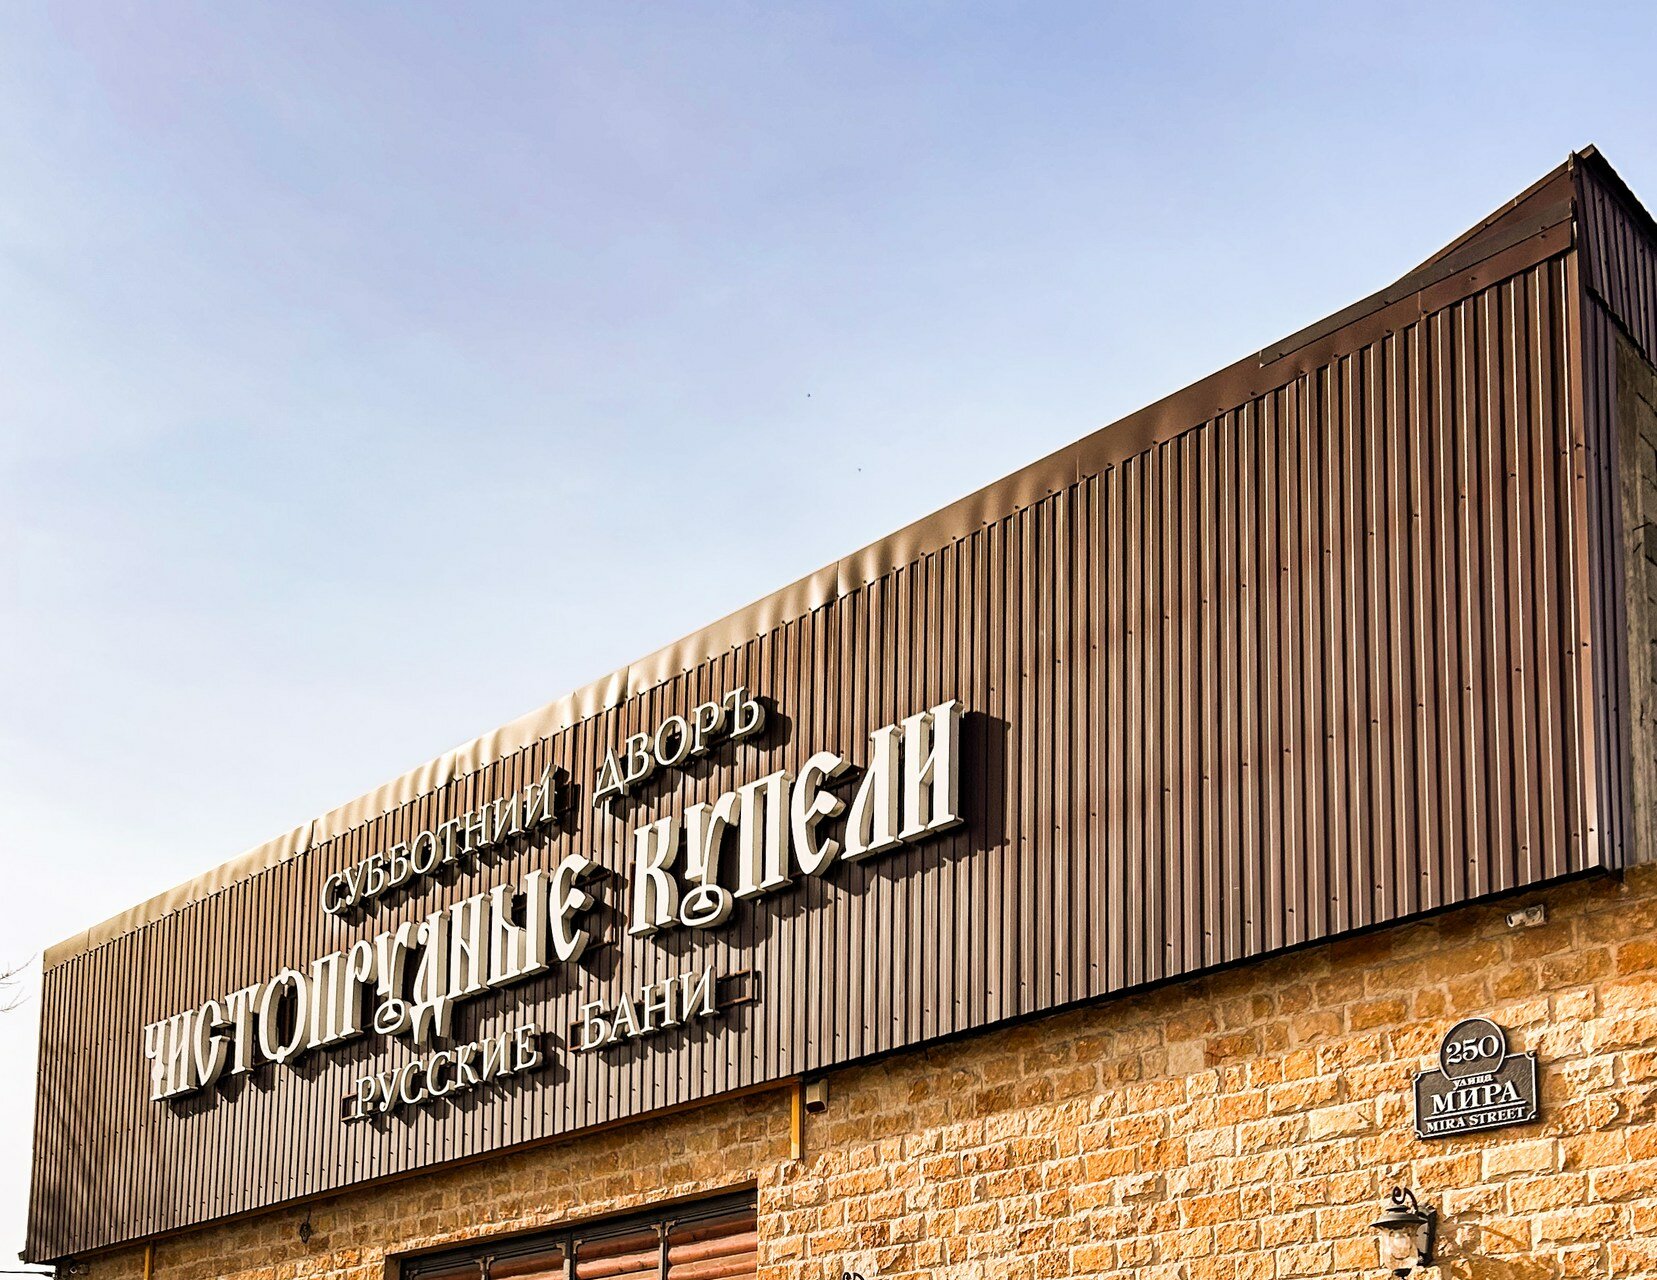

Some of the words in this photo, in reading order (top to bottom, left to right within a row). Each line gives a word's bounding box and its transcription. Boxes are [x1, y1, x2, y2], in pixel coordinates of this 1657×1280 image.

[321, 761, 559, 916] СУББОТНИЙ
[593, 685, 766, 808] ДВОРЪ
[145, 854, 600, 1101] ЧИСТОПРУДНЫЕ
[628, 698, 964, 937] КУПЕЛИ
[355, 1023, 544, 1118] РУССКИЕ
[580, 965, 719, 1052] БАНИ
[1446, 1035, 1499, 1064] 250
[1426, 1116, 1465, 1133] MIRA
[1469, 1107, 1525, 1126] STREET
[1430, 1080, 1522, 1115] МИРА
